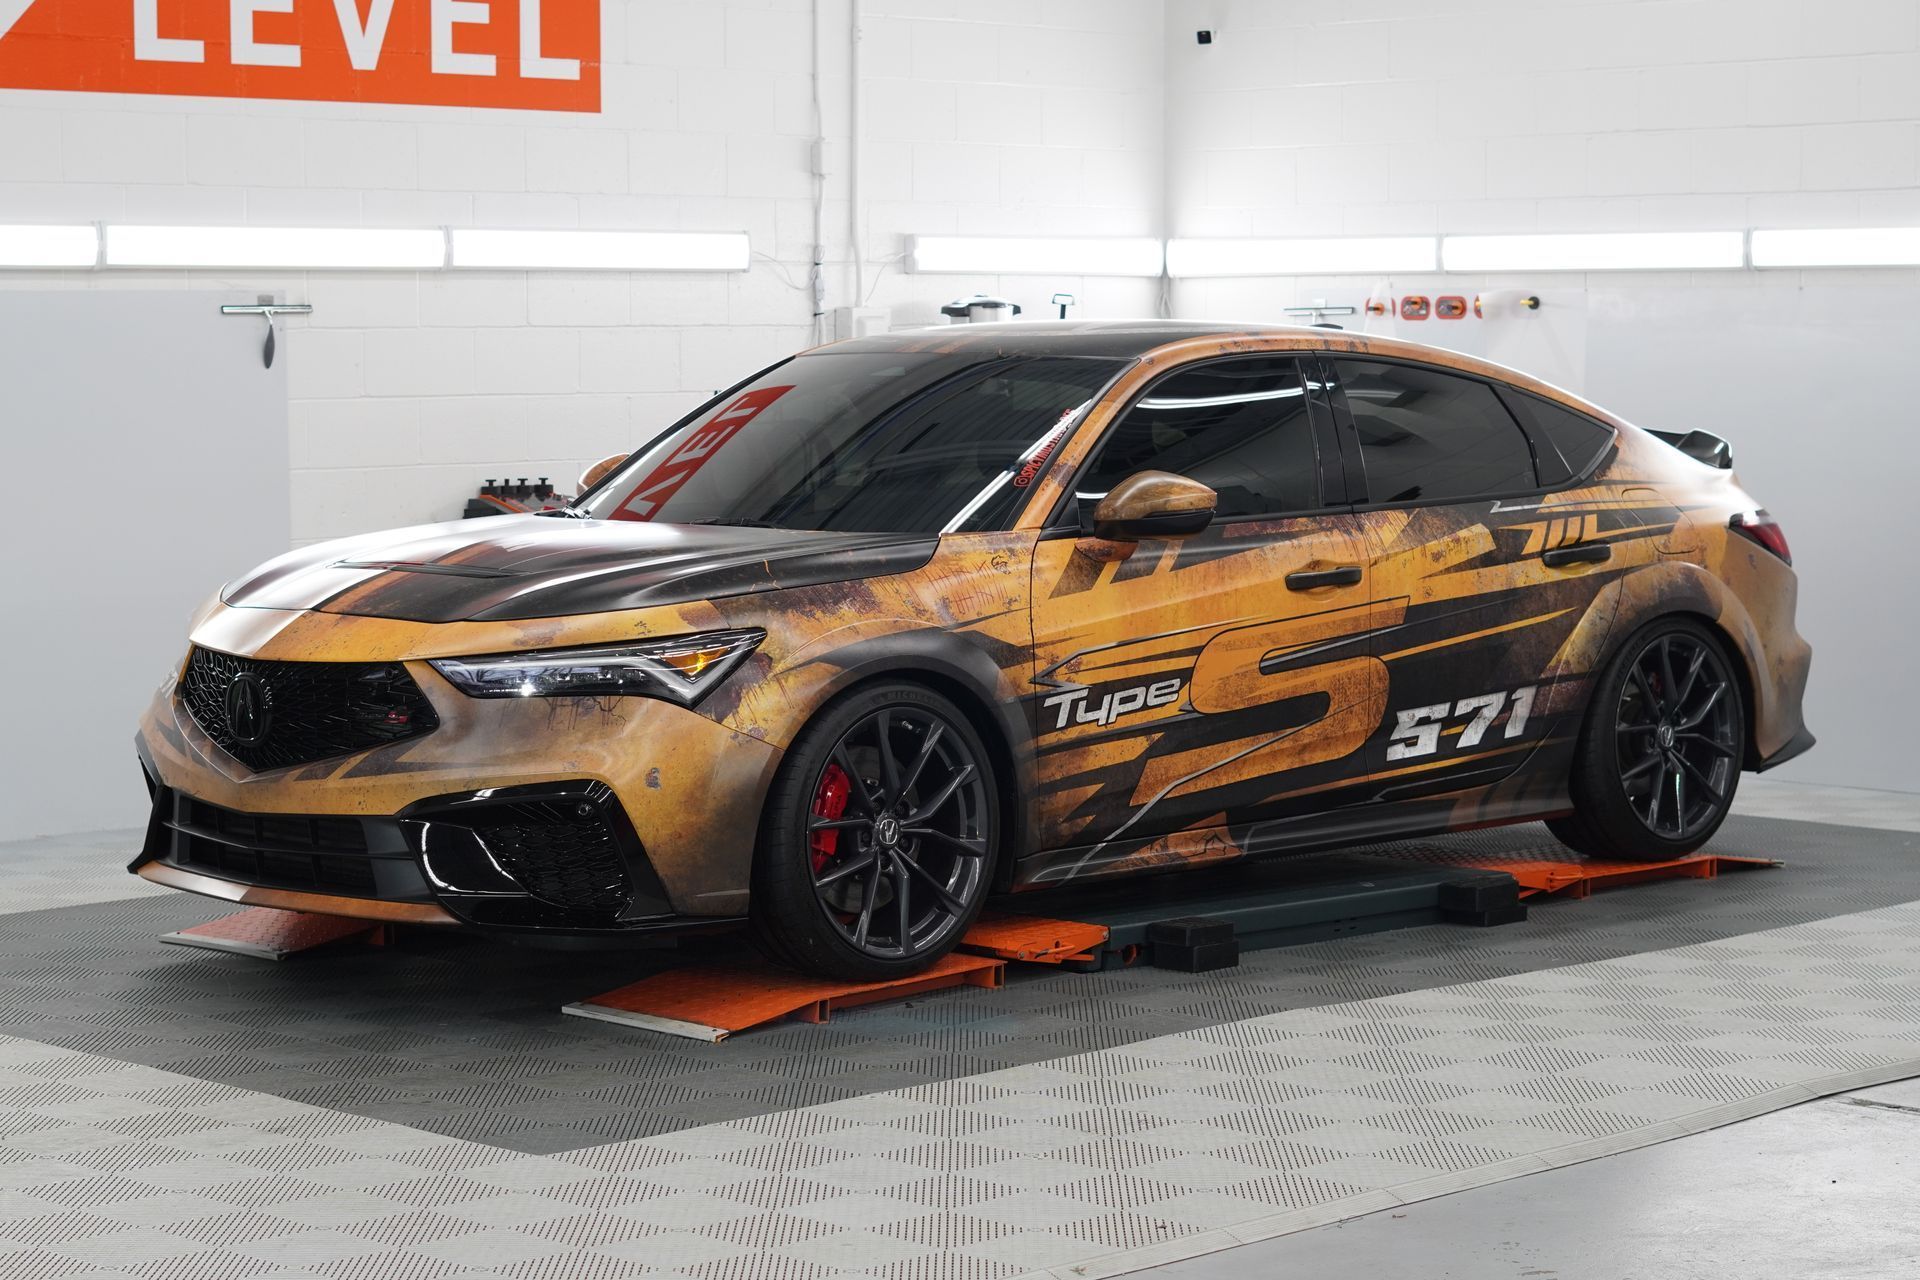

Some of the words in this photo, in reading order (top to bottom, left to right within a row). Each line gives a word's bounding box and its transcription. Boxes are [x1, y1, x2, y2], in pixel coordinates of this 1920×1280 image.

[133, 0, 581, 80] LEVEL
[1043, 677, 1182, 729] Type
[1386, 685, 1539, 762] 571
